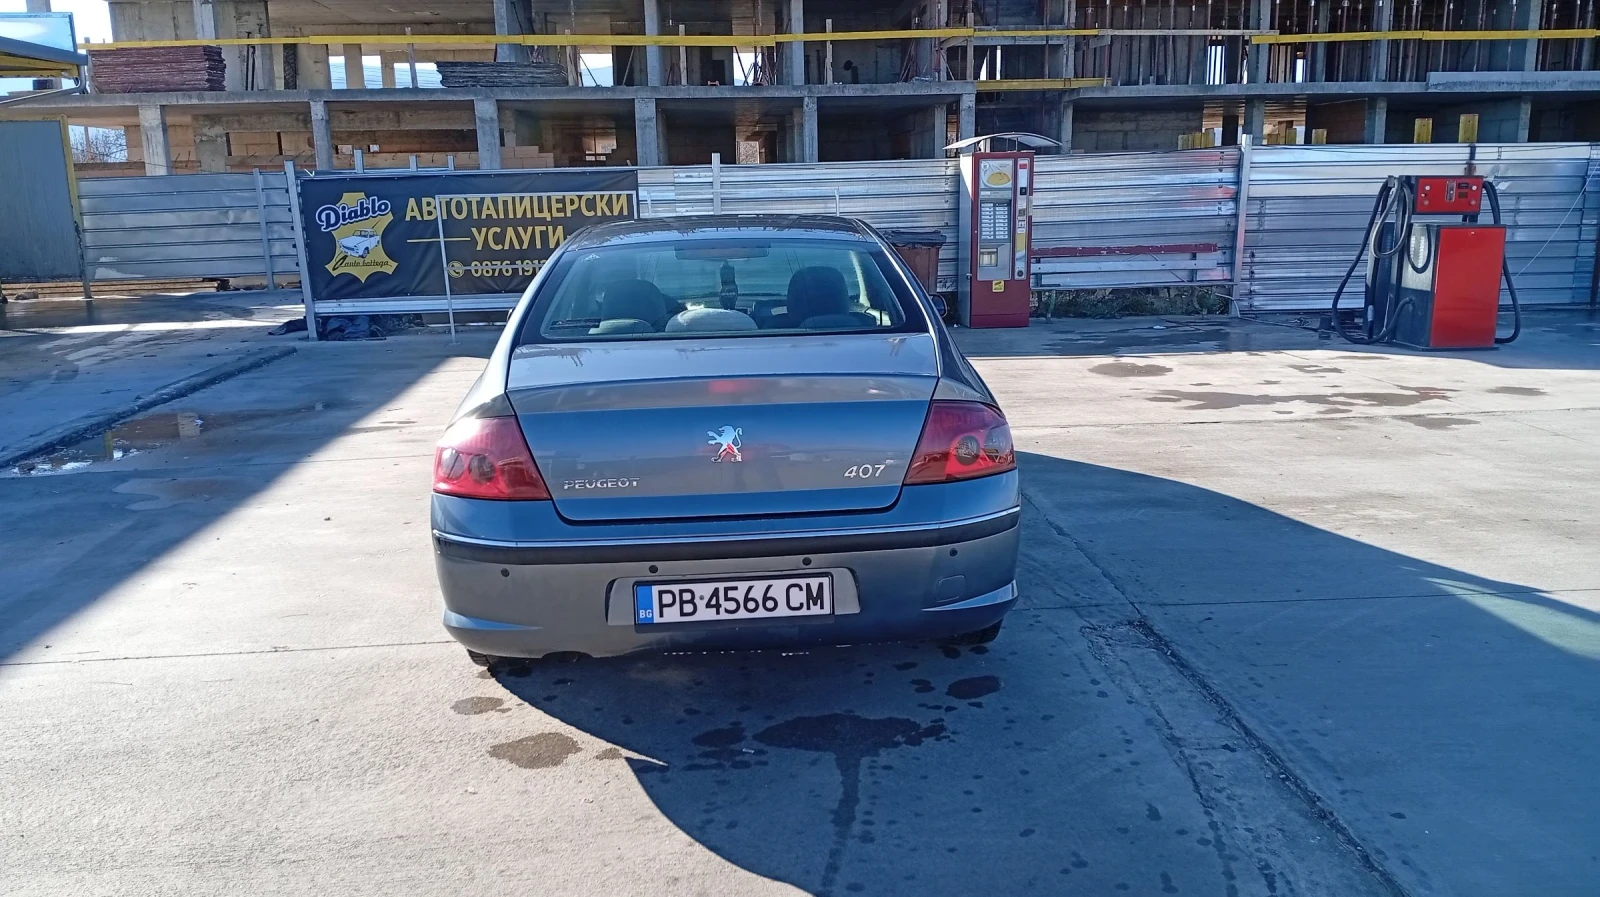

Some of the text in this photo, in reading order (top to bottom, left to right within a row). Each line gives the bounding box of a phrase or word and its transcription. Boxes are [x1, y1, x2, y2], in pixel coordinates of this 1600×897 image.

[316, 196, 391, 232] Diablo
[405, 194, 629, 221] АВТОТАПИЦЕРСКИ
[471, 225, 564, 251] УСЛУГИ
[471, 259, 547, 277] 0876 191
[844, 464, 885, 479] 407
[563, 477, 640, 490] PEUGEOT
[657, 581, 825, 618] PB 4566 CM
[639, 609, 653, 619] BG
